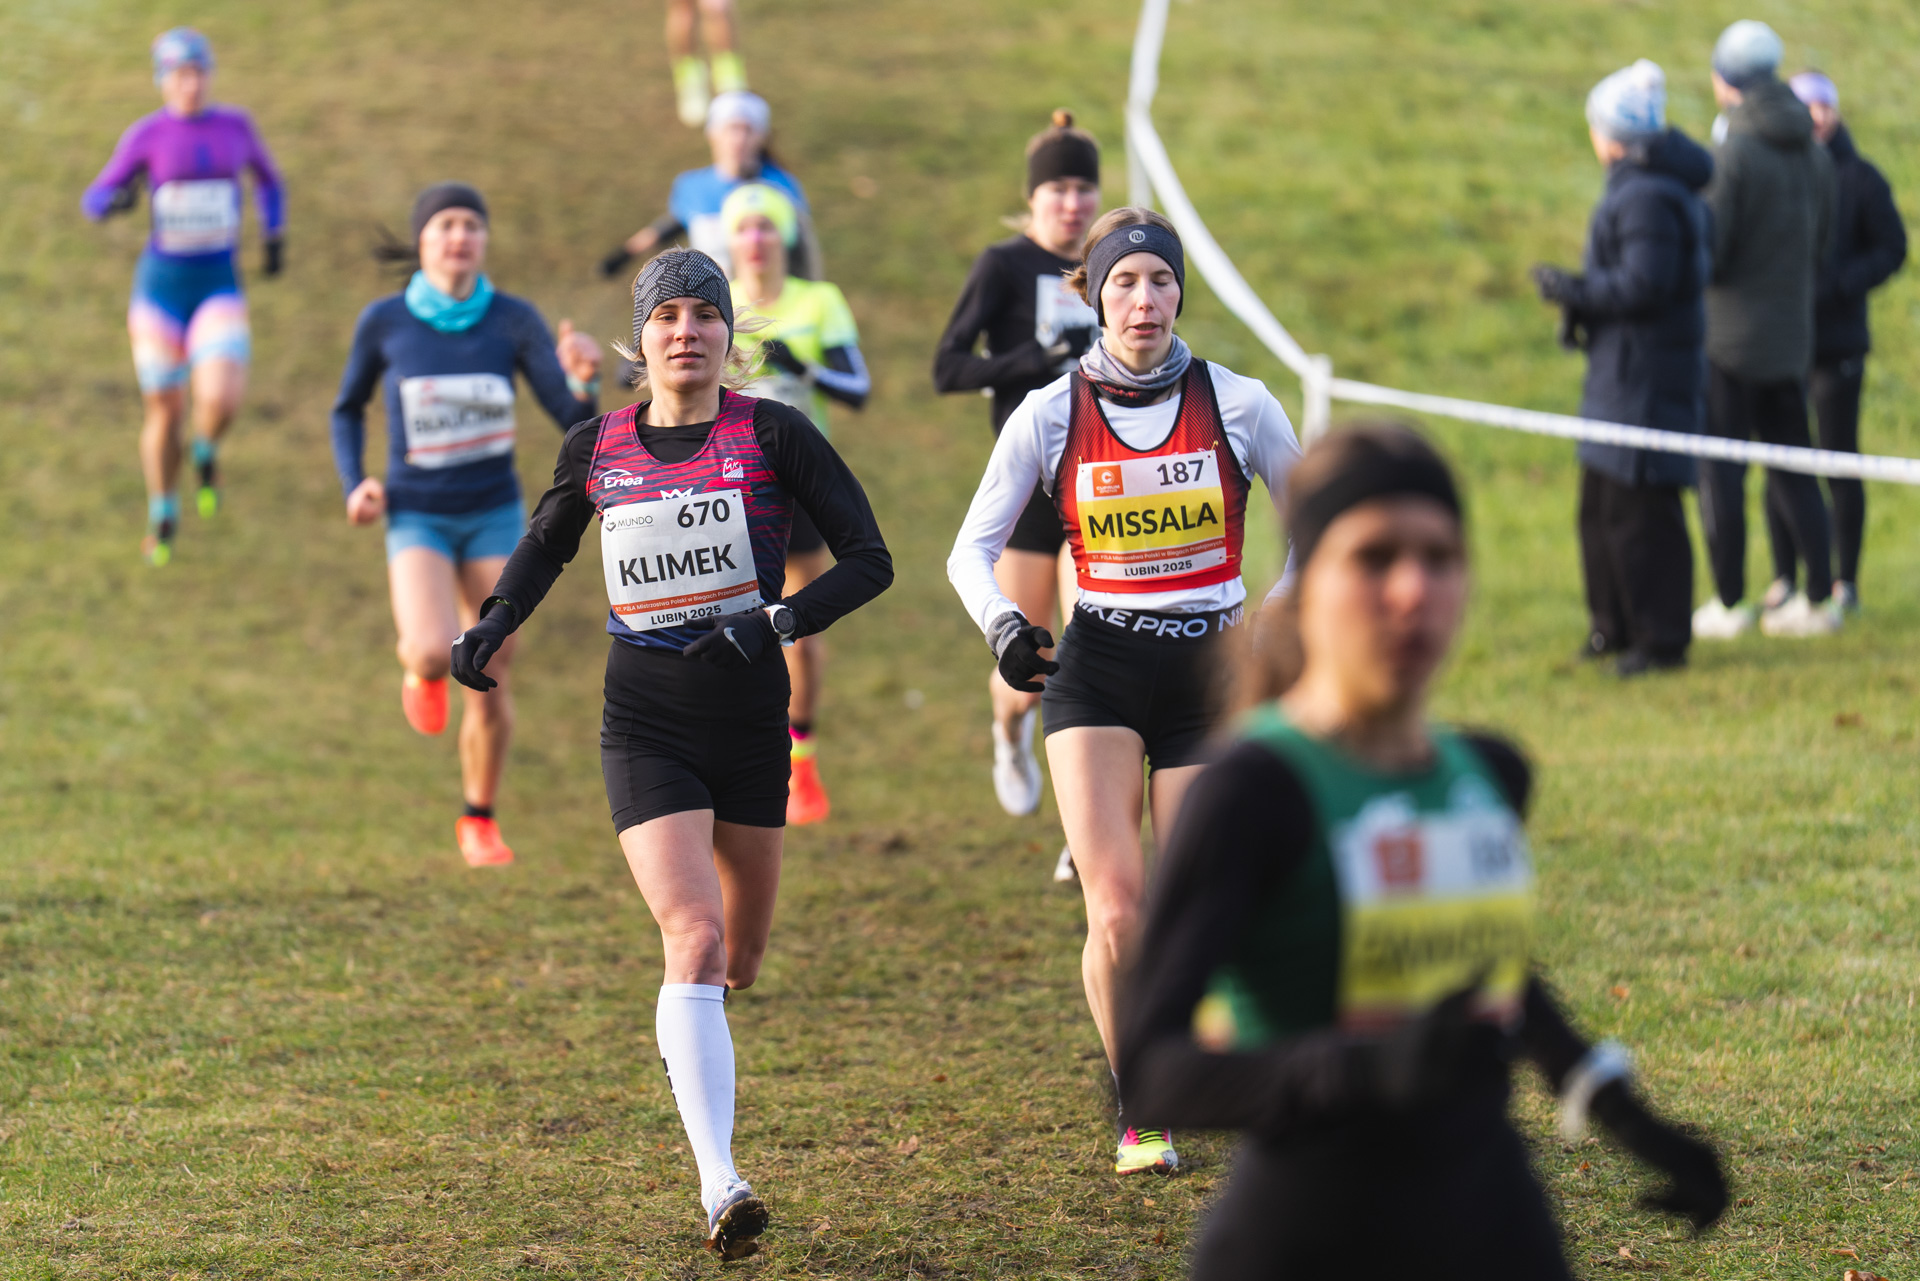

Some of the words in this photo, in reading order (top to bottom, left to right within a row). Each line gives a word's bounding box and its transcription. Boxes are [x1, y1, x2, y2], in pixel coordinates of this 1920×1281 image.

[604, 476, 644, 489] Enea
[1156, 459, 1204, 487] 187
[617, 515, 654, 528] MUNDO
[677, 498, 730, 529] 670
[1088, 502, 1218, 538] MISSALA
[1144, 550, 1160, 559] Polski
[1167, 547, 1189, 557] Biegach
[618, 543, 737, 587] KLIMEK
[1124, 565, 1160, 577] LUBIN
[1162, 560, 1192, 573] 2025
[637, 600, 670, 610] Mistrzostwa
[670, 597, 687, 605] Polski
[694, 592, 717, 601] Biegach
[650, 611, 688, 625] LUBIN
[690, 604, 722, 619] 2025
[1132, 615, 1208, 639] PRO
